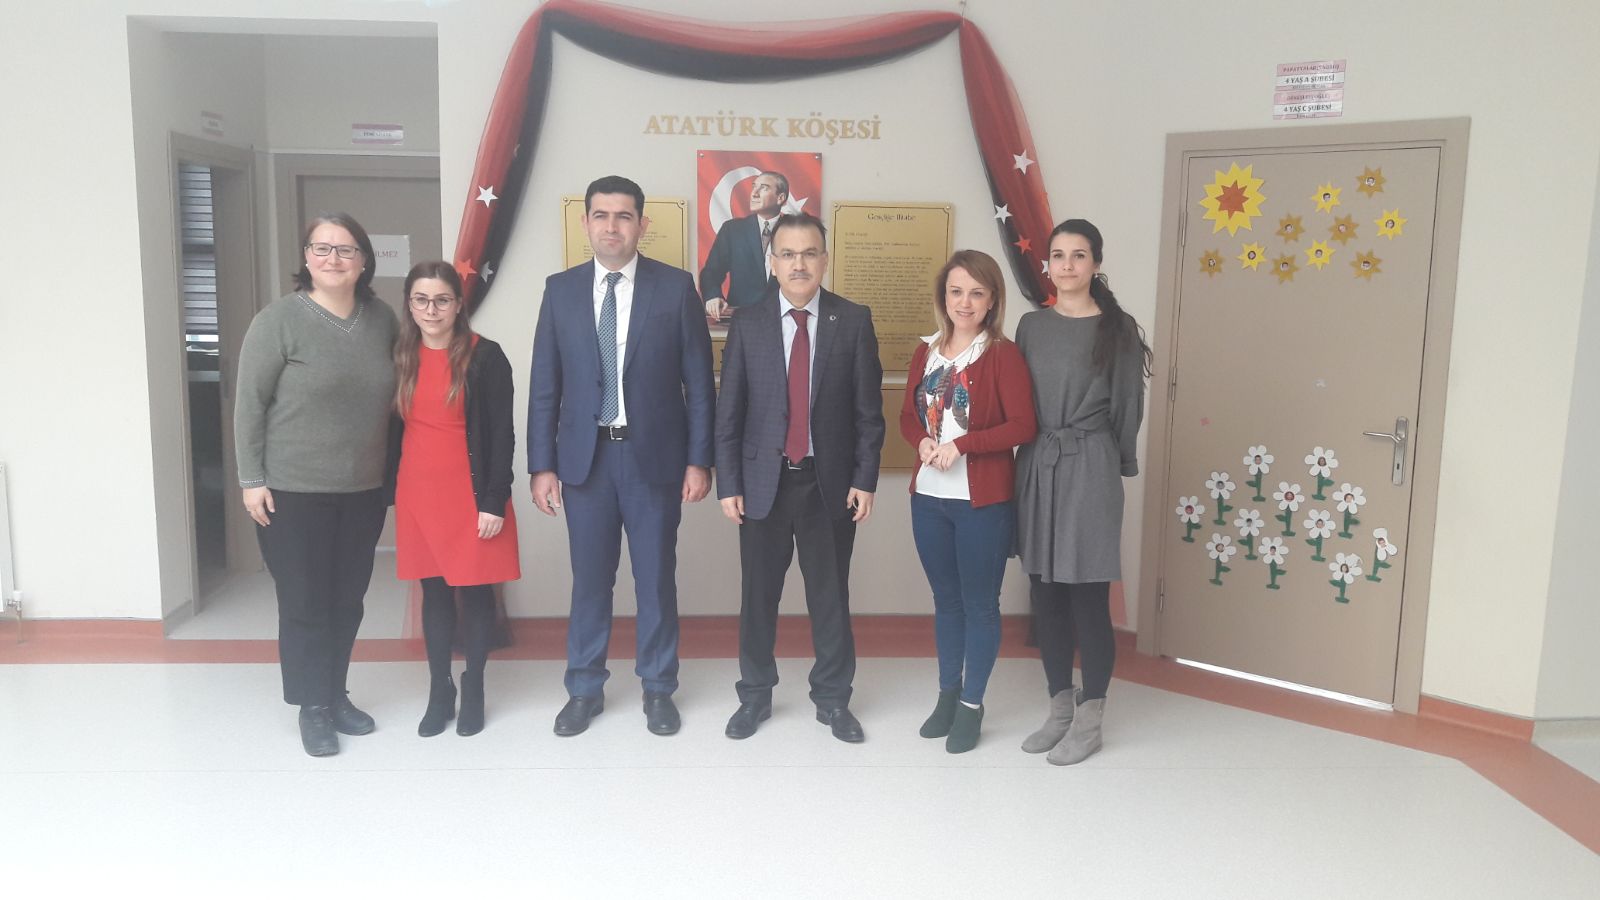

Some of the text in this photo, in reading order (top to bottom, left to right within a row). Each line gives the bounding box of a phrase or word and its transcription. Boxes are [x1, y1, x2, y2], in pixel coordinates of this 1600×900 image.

[1291, 76, 1303, 84] YAŞ
[1289, 105, 1302, 113] YAŞ
[1302, 104, 1307, 112] C
[643, 110, 882, 145] ATATÜRK KÖŞESİ
